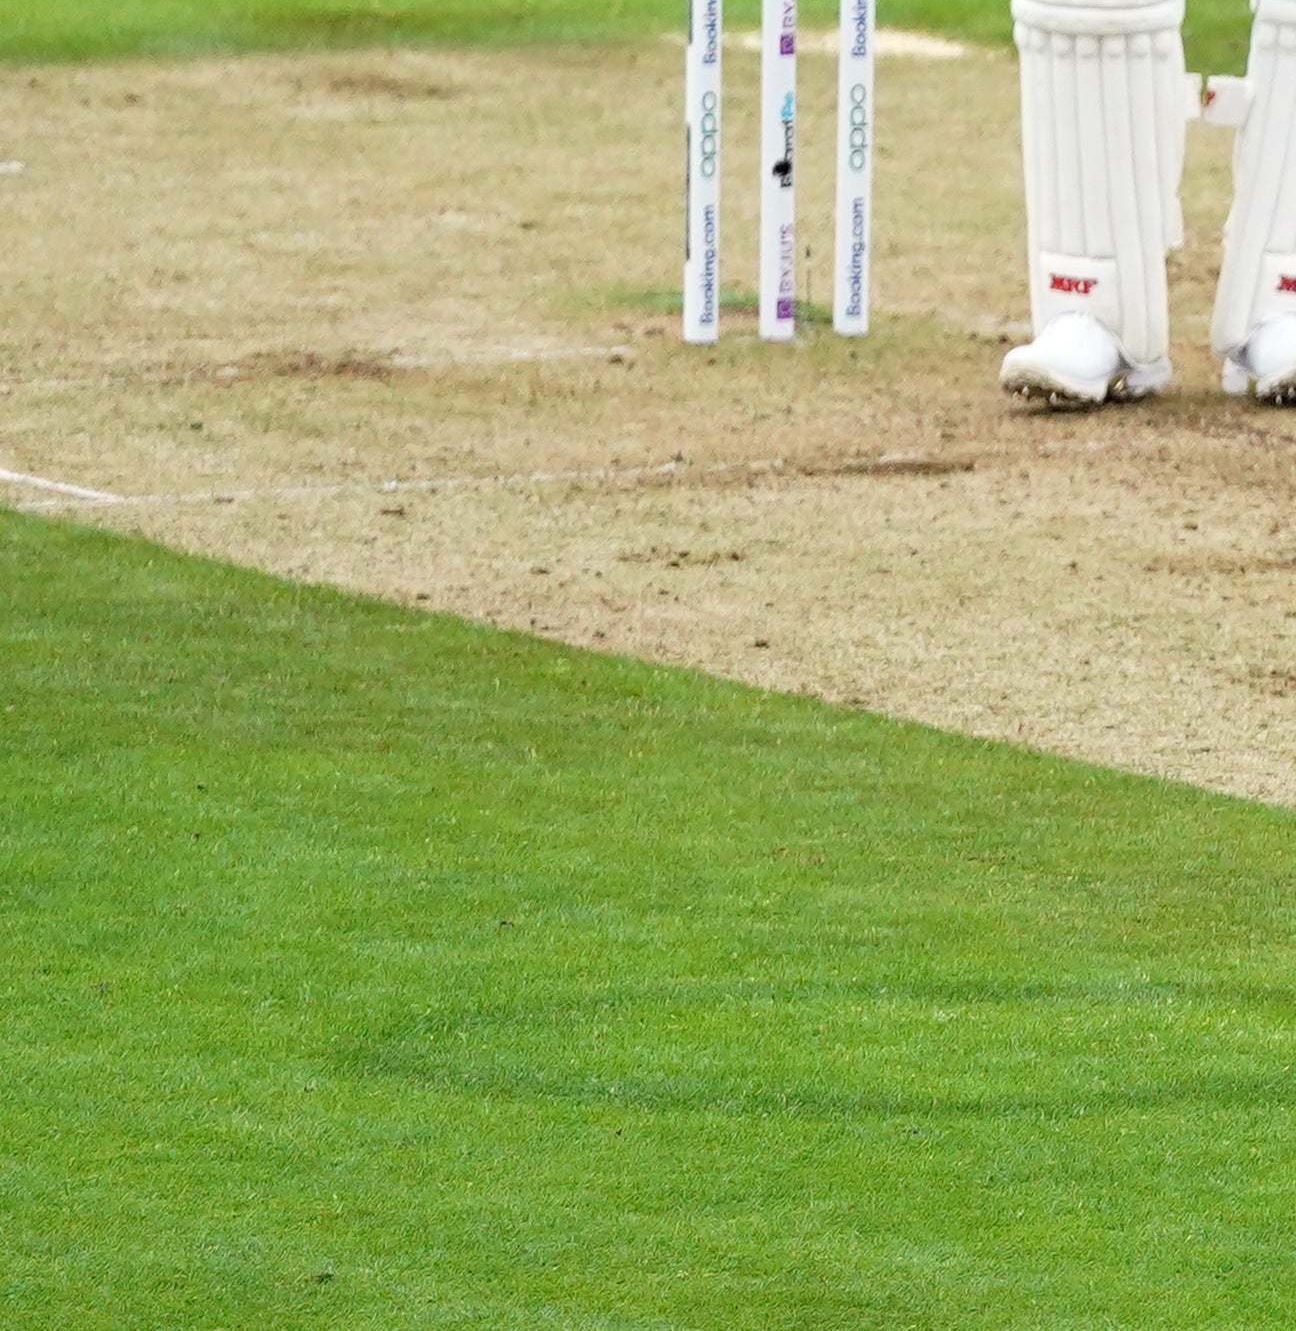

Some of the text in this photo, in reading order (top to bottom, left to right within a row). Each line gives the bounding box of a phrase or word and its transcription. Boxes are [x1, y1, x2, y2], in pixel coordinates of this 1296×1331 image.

[701, 91, 718, 178] oppo
[849, 83, 868, 171] oppo
[700, 205, 716, 324] Booking.com
[846, 197, 866, 317] Booking.com
